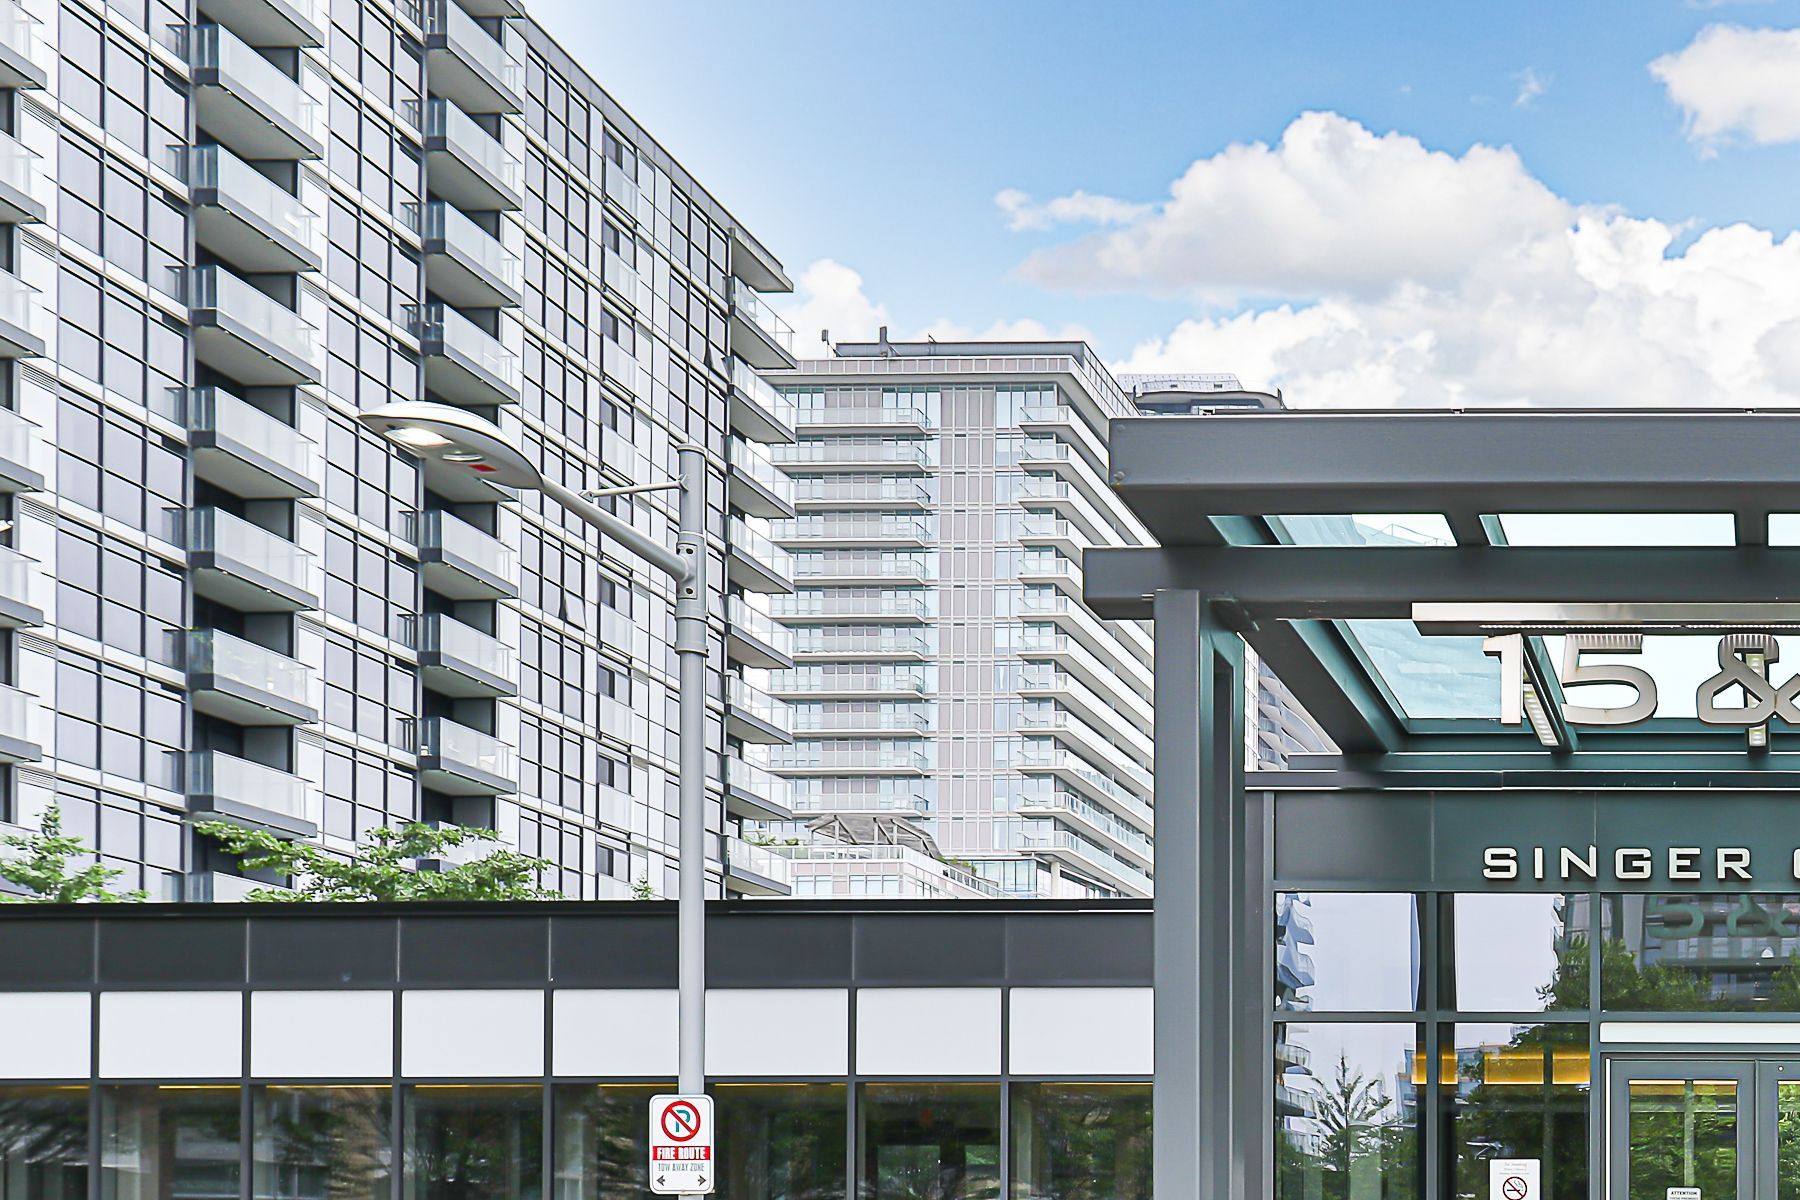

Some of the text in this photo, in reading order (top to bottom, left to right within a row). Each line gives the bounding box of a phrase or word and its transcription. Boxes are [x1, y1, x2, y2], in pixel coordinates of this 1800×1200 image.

[1482, 633, 1659, 727] 15
[1482, 845, 1753, 881] SINGER
[657, 1147, 706, 1160] FIRE ROUTE
[658, 1163, 704, 1171] TOW AWAY ZONE
